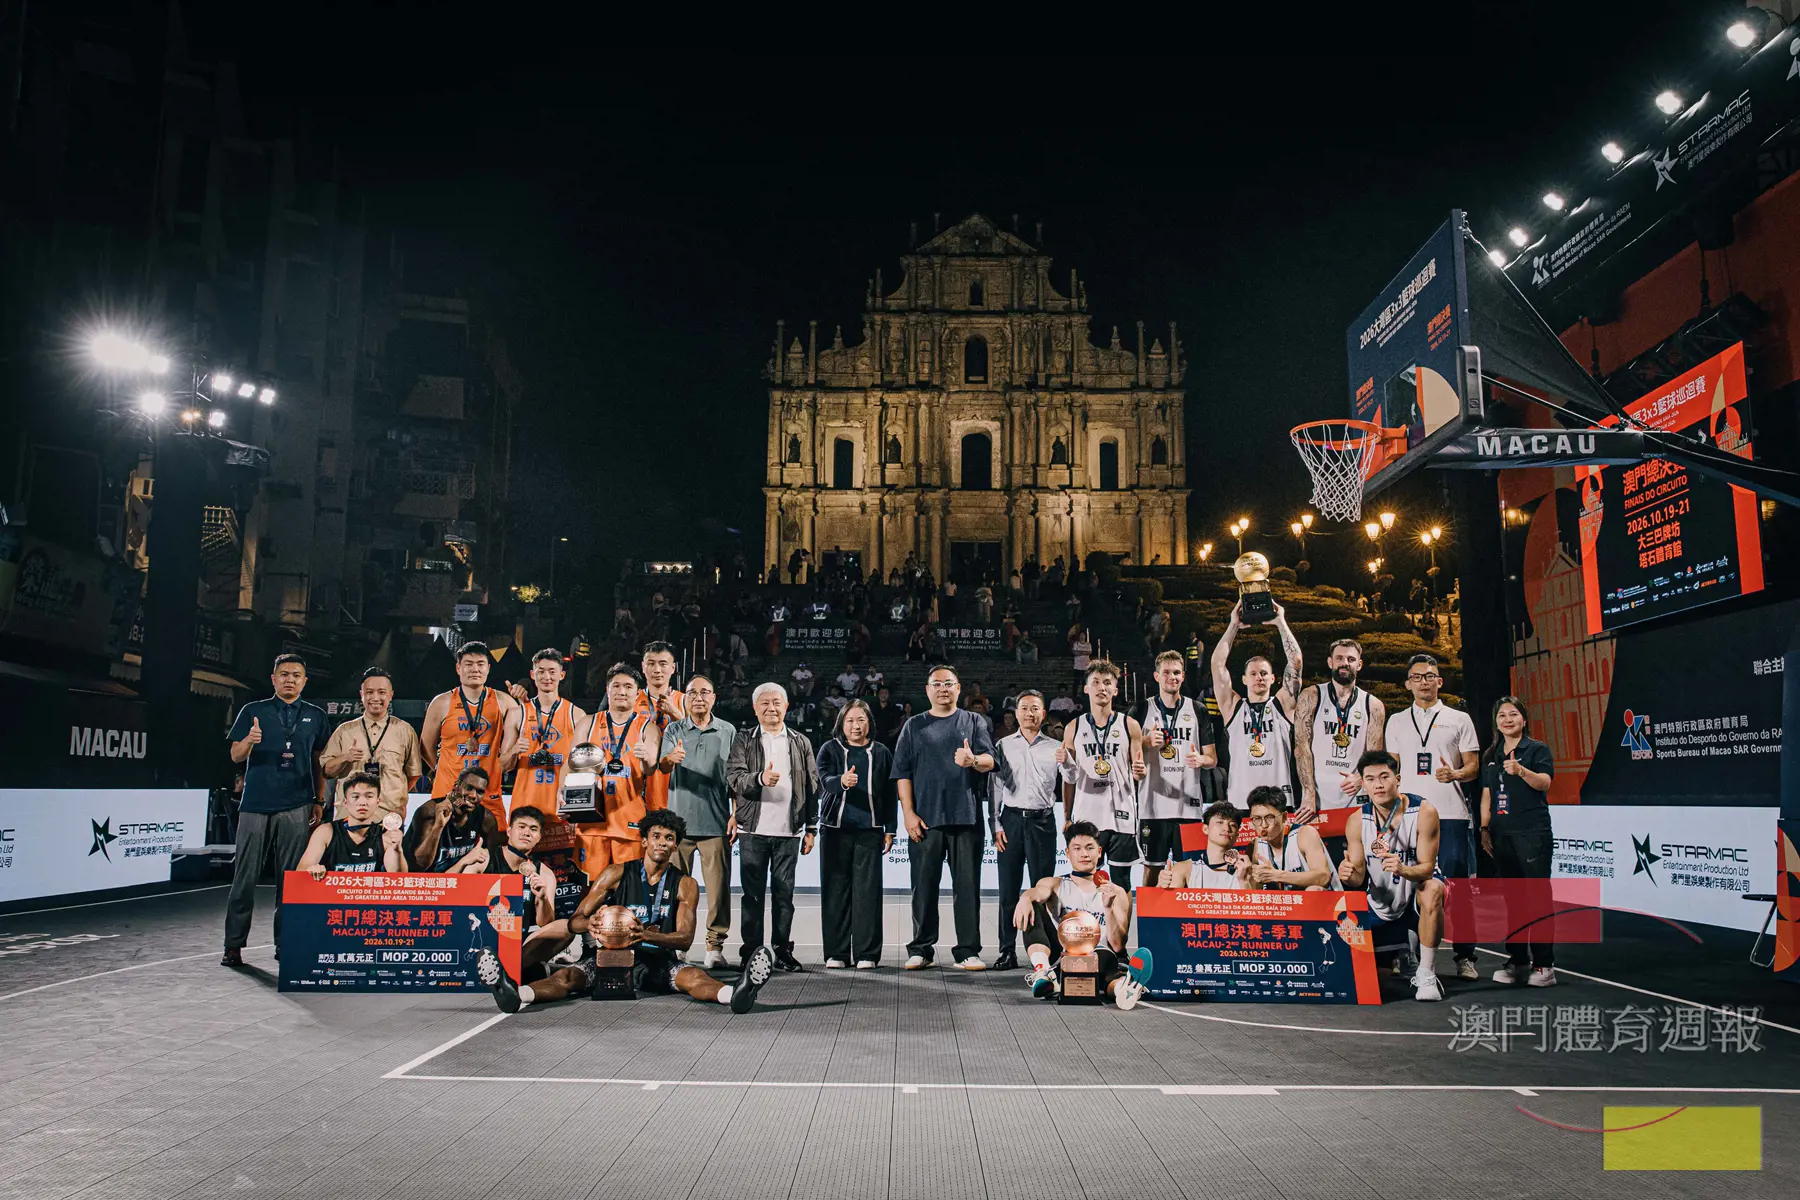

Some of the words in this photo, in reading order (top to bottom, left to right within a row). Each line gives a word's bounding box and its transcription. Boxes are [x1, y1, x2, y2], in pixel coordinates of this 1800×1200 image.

[1678, 89, 1750, 155] STARMAC
[1477, 434, 1596, 456] MACAU
[1624, 493, 1644, 510] FINAIS
[1645, 489, 1655, 501] DO
[1656, 474, 1688, 496] CIRCUITO
[1627, 498, 1690, 535] 2026.10.19-21
[1637, 520, 1680, 550] 大三巴牌坊
[1639, 540, 1682, 568] 塔石體育館
[1323, 720, 1361, 739] WLF
[1654, 715, 1749, 734] 澳門特別行政區政府體育局
[70, 726, 147, 759] MACAU
[1655, 736, 1678, 746] Instituto
[1679, 736, 1687, 745] do
[1688, 734, 1717, 747] Desporto
[1718, 733, 1727, 742] do
[1729, 731, 1759, 741] Governo
[1760, 729, 1770, 740] da
[1082, 743, 1120, 757] WLF
[1656, 749, 1676, 760] Sports
[1677, 748, 1700, 758] Bureau
[1701, 747, 1708, 756] of
[1709, 746, 1732, 756] Macao
[1733, 744, 1749, 755] SAR
[119, 822, 184, 835] STARMAC
[1552, 838, 1613, 852] STARMAC
[1661, 843, 1749, 863] STARMAC
[1581, 853, 1605, 864] Production
[1663, 859, 1703, 872] Entertainment
[1703, 861, 1738, 875] Production
[1738, 867, 1749, 876] Ltd
[1671, 872, 1750, 893] 澳門星娛樂製作有限公司
[326, 909, 453, 926] 澳門總決賽-殿軍
[387, 928, 429, 937] RUNNER
[431, 929, 446, 938] UP
[1181, 923, 1303, 940] 澳門總決賽-季軍
[364, 938, 415, 946] 2026.10.19-21
[1241, 941, 1283, 950] RUNNER
[1285, 942, 1298, 950] UP
[382, 952, 409, 961] MOP
[411, 952, 452, 963] 20,000
[1239, 963, 1265, 973] MOP
[1268, 964, 1308, 974] 30,000
